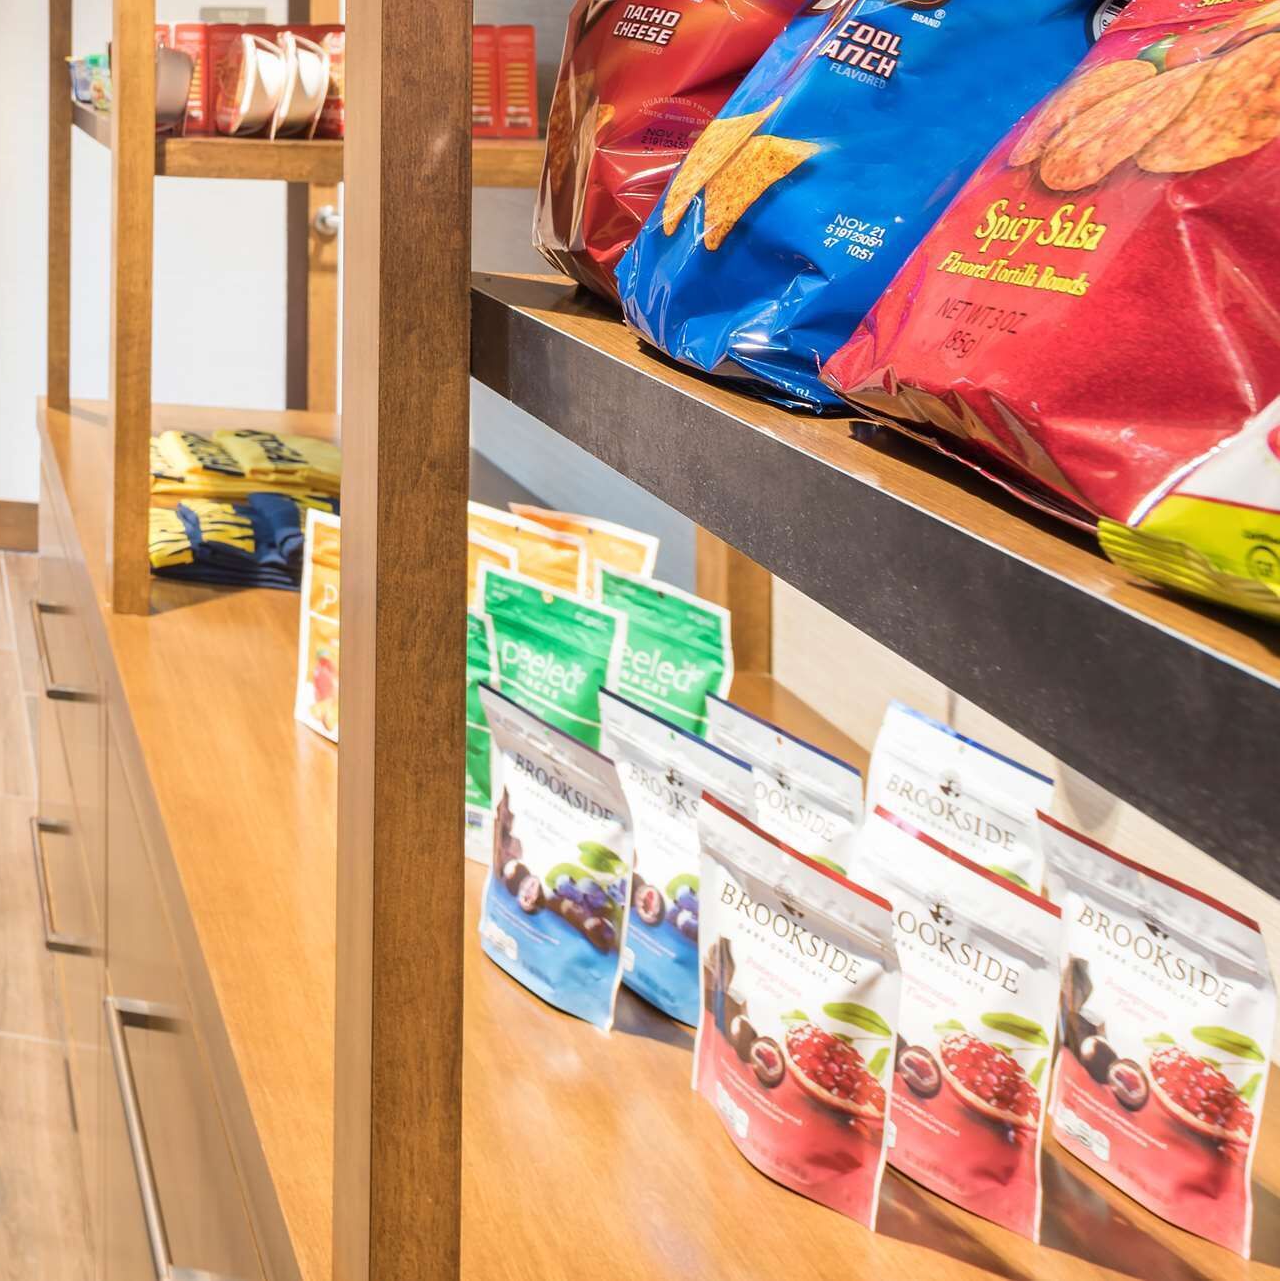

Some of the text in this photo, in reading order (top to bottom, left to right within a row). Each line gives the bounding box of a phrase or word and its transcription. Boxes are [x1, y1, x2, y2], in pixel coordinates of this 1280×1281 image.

[612, 20, 674, 46] CHEESE
[623, 3, 682, 28] NACHO
[837, 19, 902, 56] COOL
[911, 12, 941, 29] BRAND
[819, 38, 897, 79] ANCH
[829, 62, 887, 90] FLAVORED
[645, 127, 673, 139] NOV
[834, 213, 886, 239] NOV 21
[974, 198, 1108, 256] Spicy Salsa
[936, 250, 1092, 298] Flavored Tortilla Rounds
[935, 297, 973, 320] NET
[967, 303, 996, 327] WT
[501, 640, 575, 695] peeled
[622, 643, 693, 694] eeled
[514, 753, 615, 821] BROOKSIDE
[629, 761, 698, 819] BROOKS
[753, 780, 834, 844] OOKSIDE
[886, 773, 1017, 851] BROOKSIDE
[720, 881, 863, 985] BROOKSIDE
[897, 909, 1020, 994] OOKSIDE
[1077, 903, 1234, 1009] BROOKSIDE
